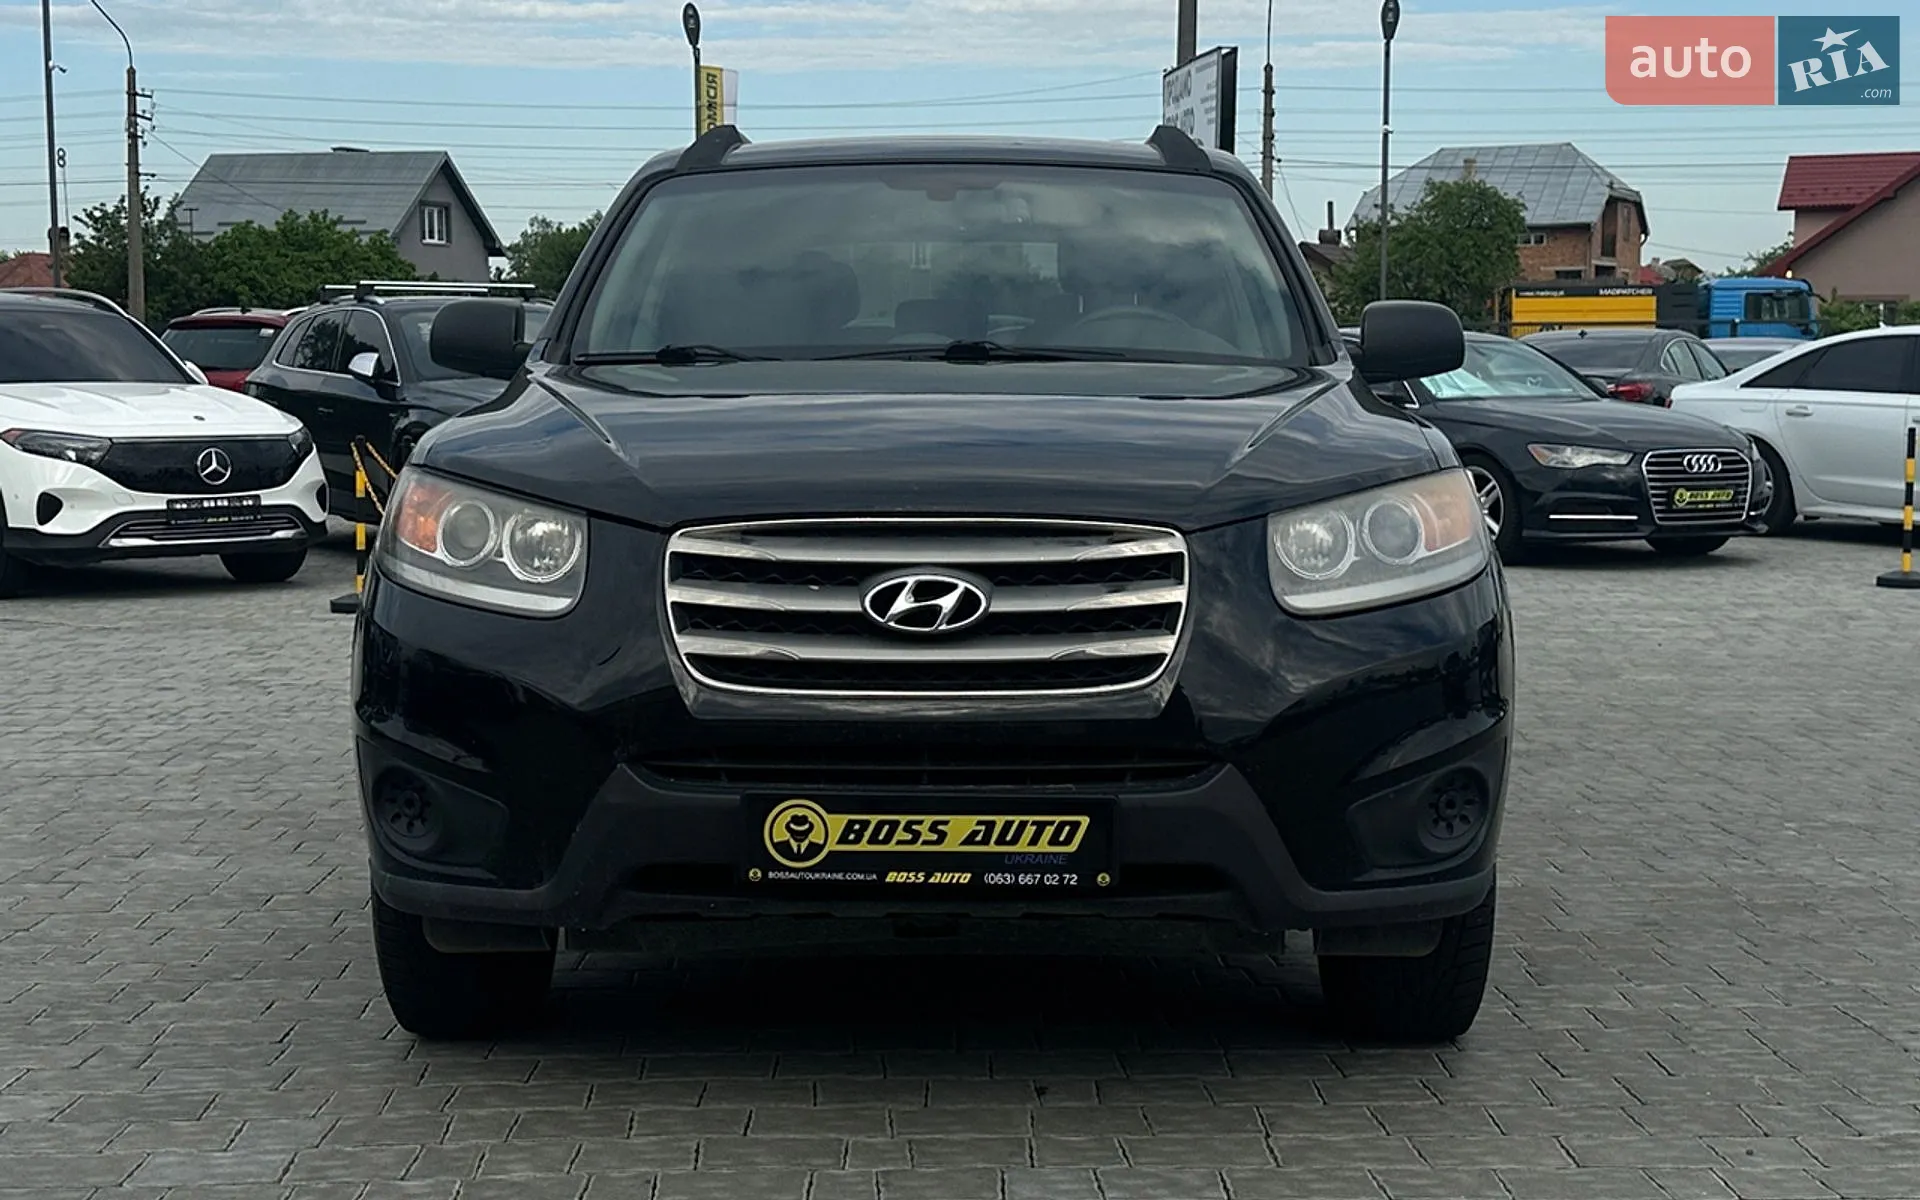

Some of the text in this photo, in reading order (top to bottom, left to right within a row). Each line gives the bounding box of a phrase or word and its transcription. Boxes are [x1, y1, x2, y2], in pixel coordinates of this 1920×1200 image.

[835, 818, 1083, 847] BOSS AUTO
[1004, 854, 1069, 865] UKRAINE
[767, 871, 1078, 885] BOSSAUTOUKRAINE.COM.UA BOSS AUTO (063) 667 02 72
